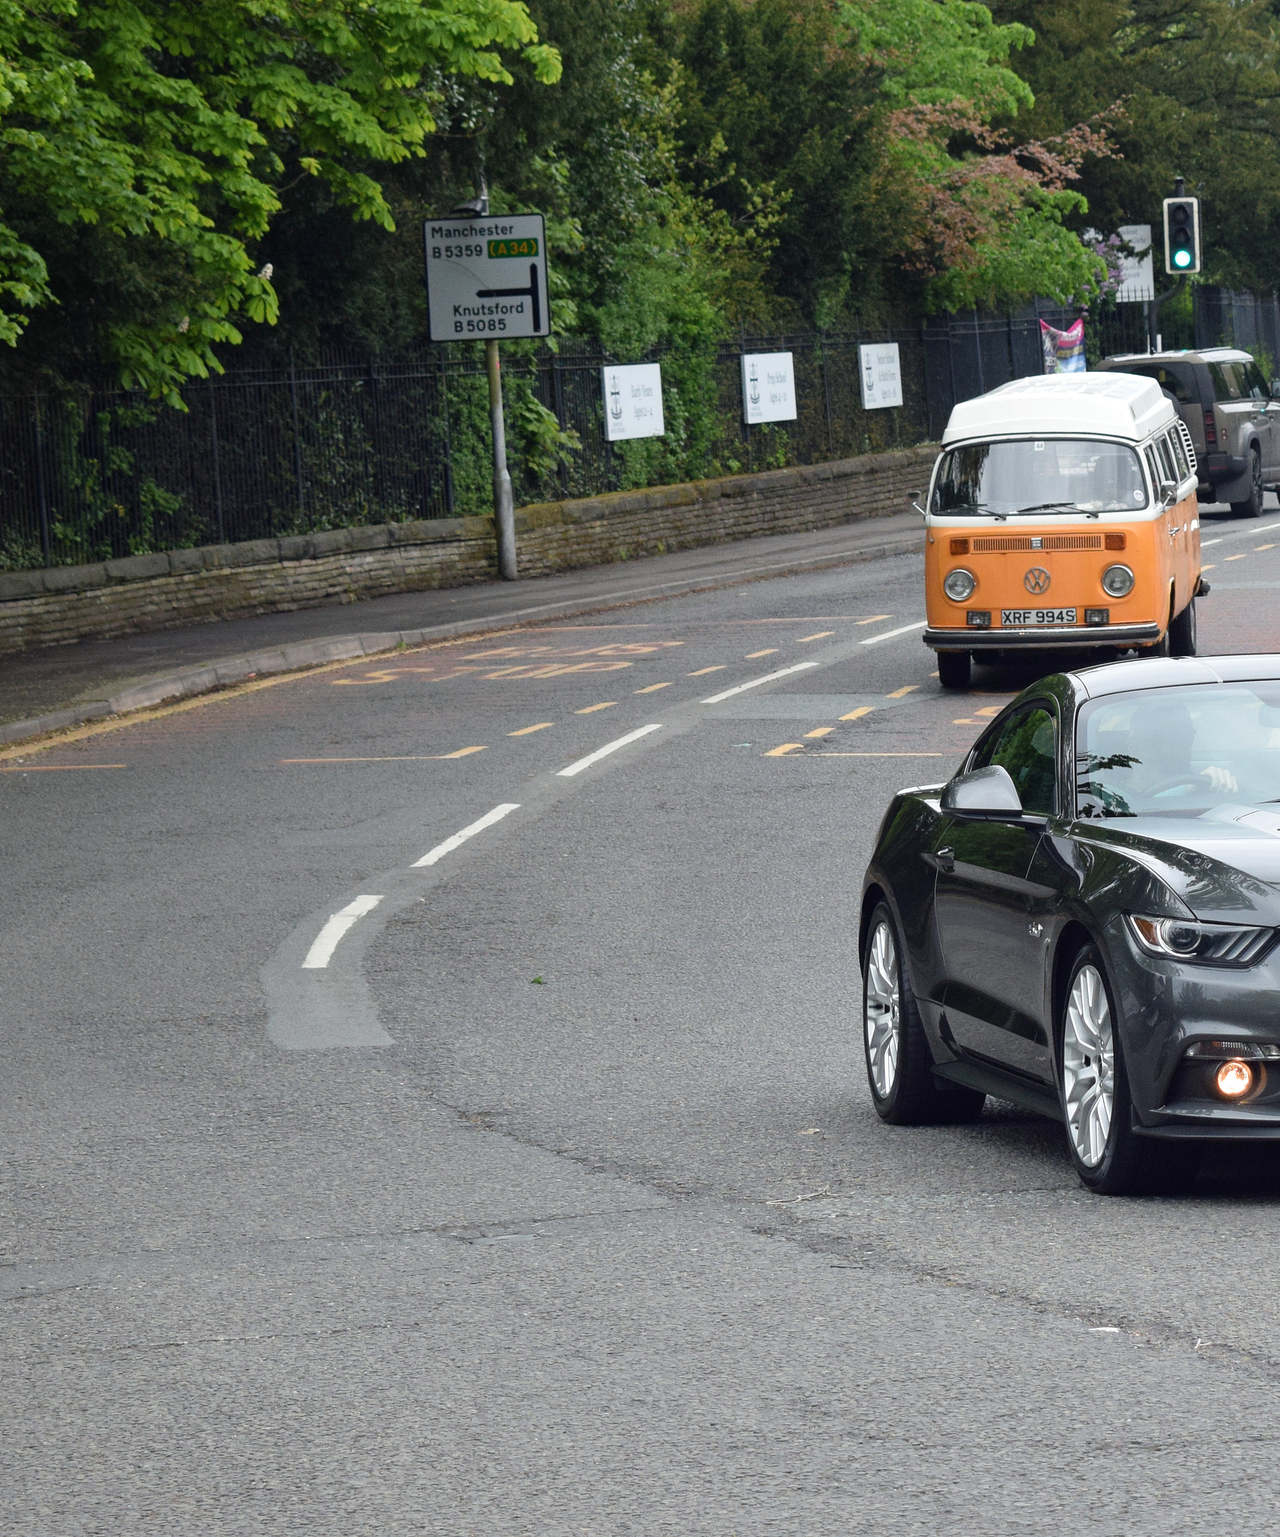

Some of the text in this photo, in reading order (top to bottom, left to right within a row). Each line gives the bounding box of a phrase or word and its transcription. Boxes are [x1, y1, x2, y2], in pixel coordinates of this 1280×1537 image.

[431, 224, 514, 238] Manchester
[453, 301, 524, 317] Knutsford
[1003, 610, 1075, 624] XRF 994S
[332, 661, 634, 685] STOP
